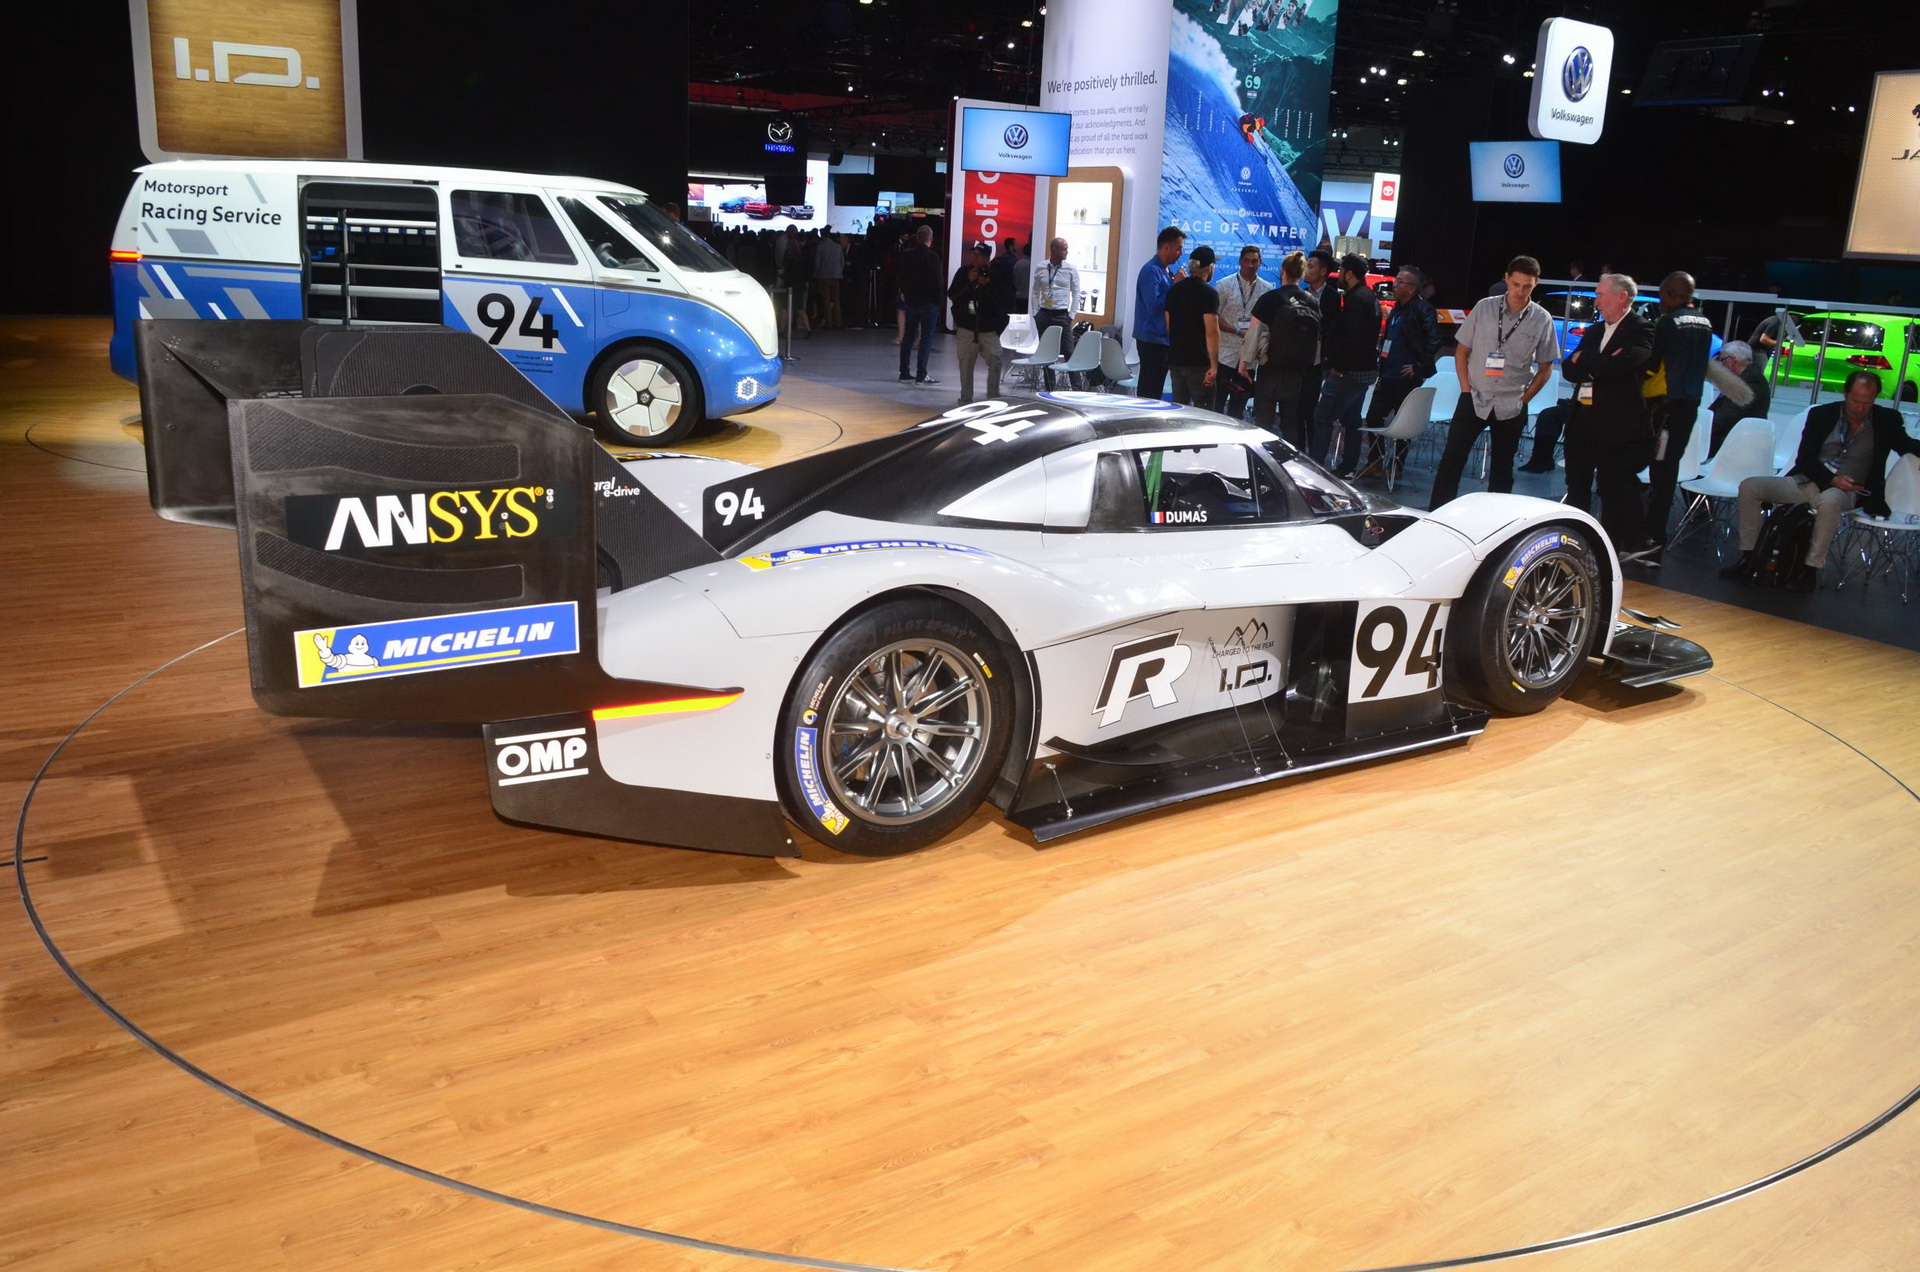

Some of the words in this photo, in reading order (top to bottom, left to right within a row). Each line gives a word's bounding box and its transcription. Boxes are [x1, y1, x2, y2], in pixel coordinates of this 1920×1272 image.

[1047, 79, 1072, 94] We're
[1073, 74, 1118, 94] positively
[1120, 70, 1158, 87] thrilled.
[1245, 75, 1261, 90] 69
[1133, 104, 1149, 114] really
[1551, 108, 1594, 126] Volkswagen
[1134, 118, 1146, 126] And
[1081, 133, 1096, 143] proud
[1097, 132, 1103, 141] of
[1111, 132, 1120, 140] the
[1121, 132, 1134, 140] hard
[1134, 132, 1148, 140] work
[999, 152, 1032, 160] Volkswagen
[1094, 146, 1105, 154] that
[1105, 146, 1115, 156] got
[1116, 146, 1123, 154] us
[144, 179, 229, 197] Motorsport
[141, 202, 207, 225] Racing
[212, 206, 282, 225] Service
[1220, 222, 1239, 234] OF
[1246, 223, 1307, 239] WINTER
[476, 293, 559, 349] 94
[918, 401, 1049, 445] 94
[604, 486, 640, 497] e-drive
[715, 488, 765, 526] 94
[1165, 511, 1208, 523] DUMAS
[820, 541, 968, 554] MICHELIN
[1521, 536, 1558, 565] MICHELIN
[382, 621, 555, 659] MICHELIN
[1212, 647, 1242, 658] CHARGED
[1251, 643, 1261, 652] THE
[1262, 640, 1275, 649] PEAK
[1356, 603, 1443, 698] 94
[1091, 628, 1192, 729] R
[497, 737, 587, 776] OMP
[800, 731, 824, 807] MICHELIN
